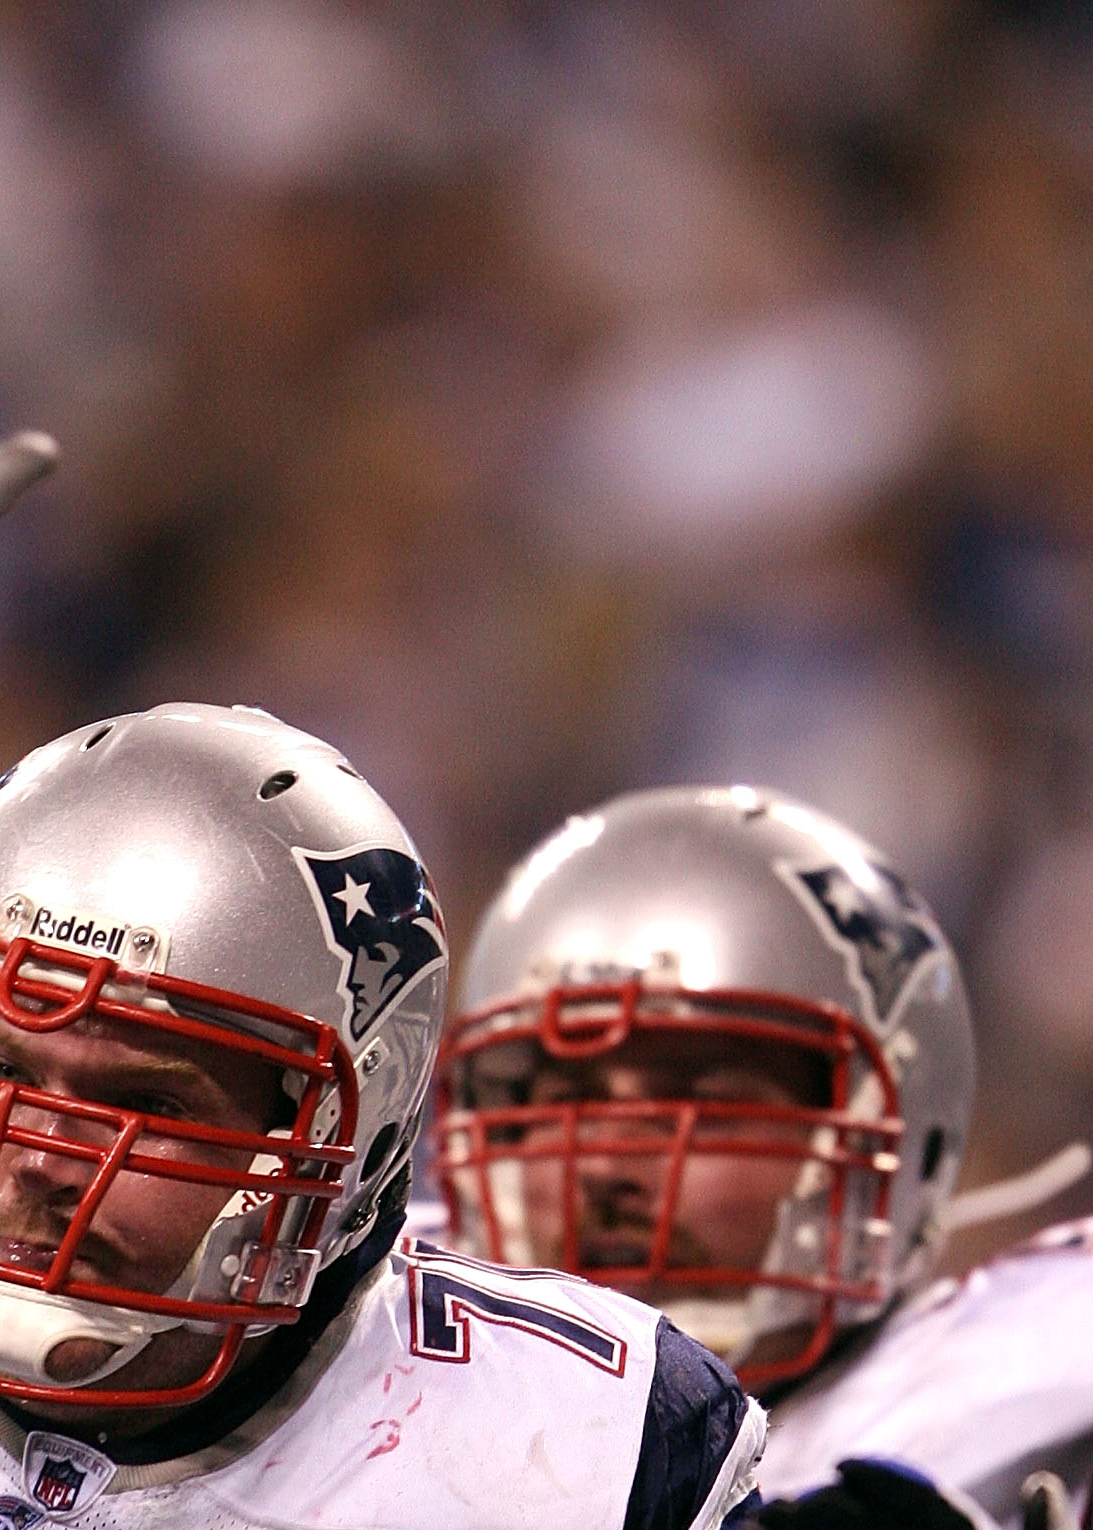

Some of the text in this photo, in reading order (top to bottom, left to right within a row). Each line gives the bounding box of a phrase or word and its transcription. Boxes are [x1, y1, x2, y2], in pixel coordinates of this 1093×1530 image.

[30, 906, 125, 955] Riddell
[407, 1264, 627, 1378] 7
[37, 1474, 75, 1509] NFL
